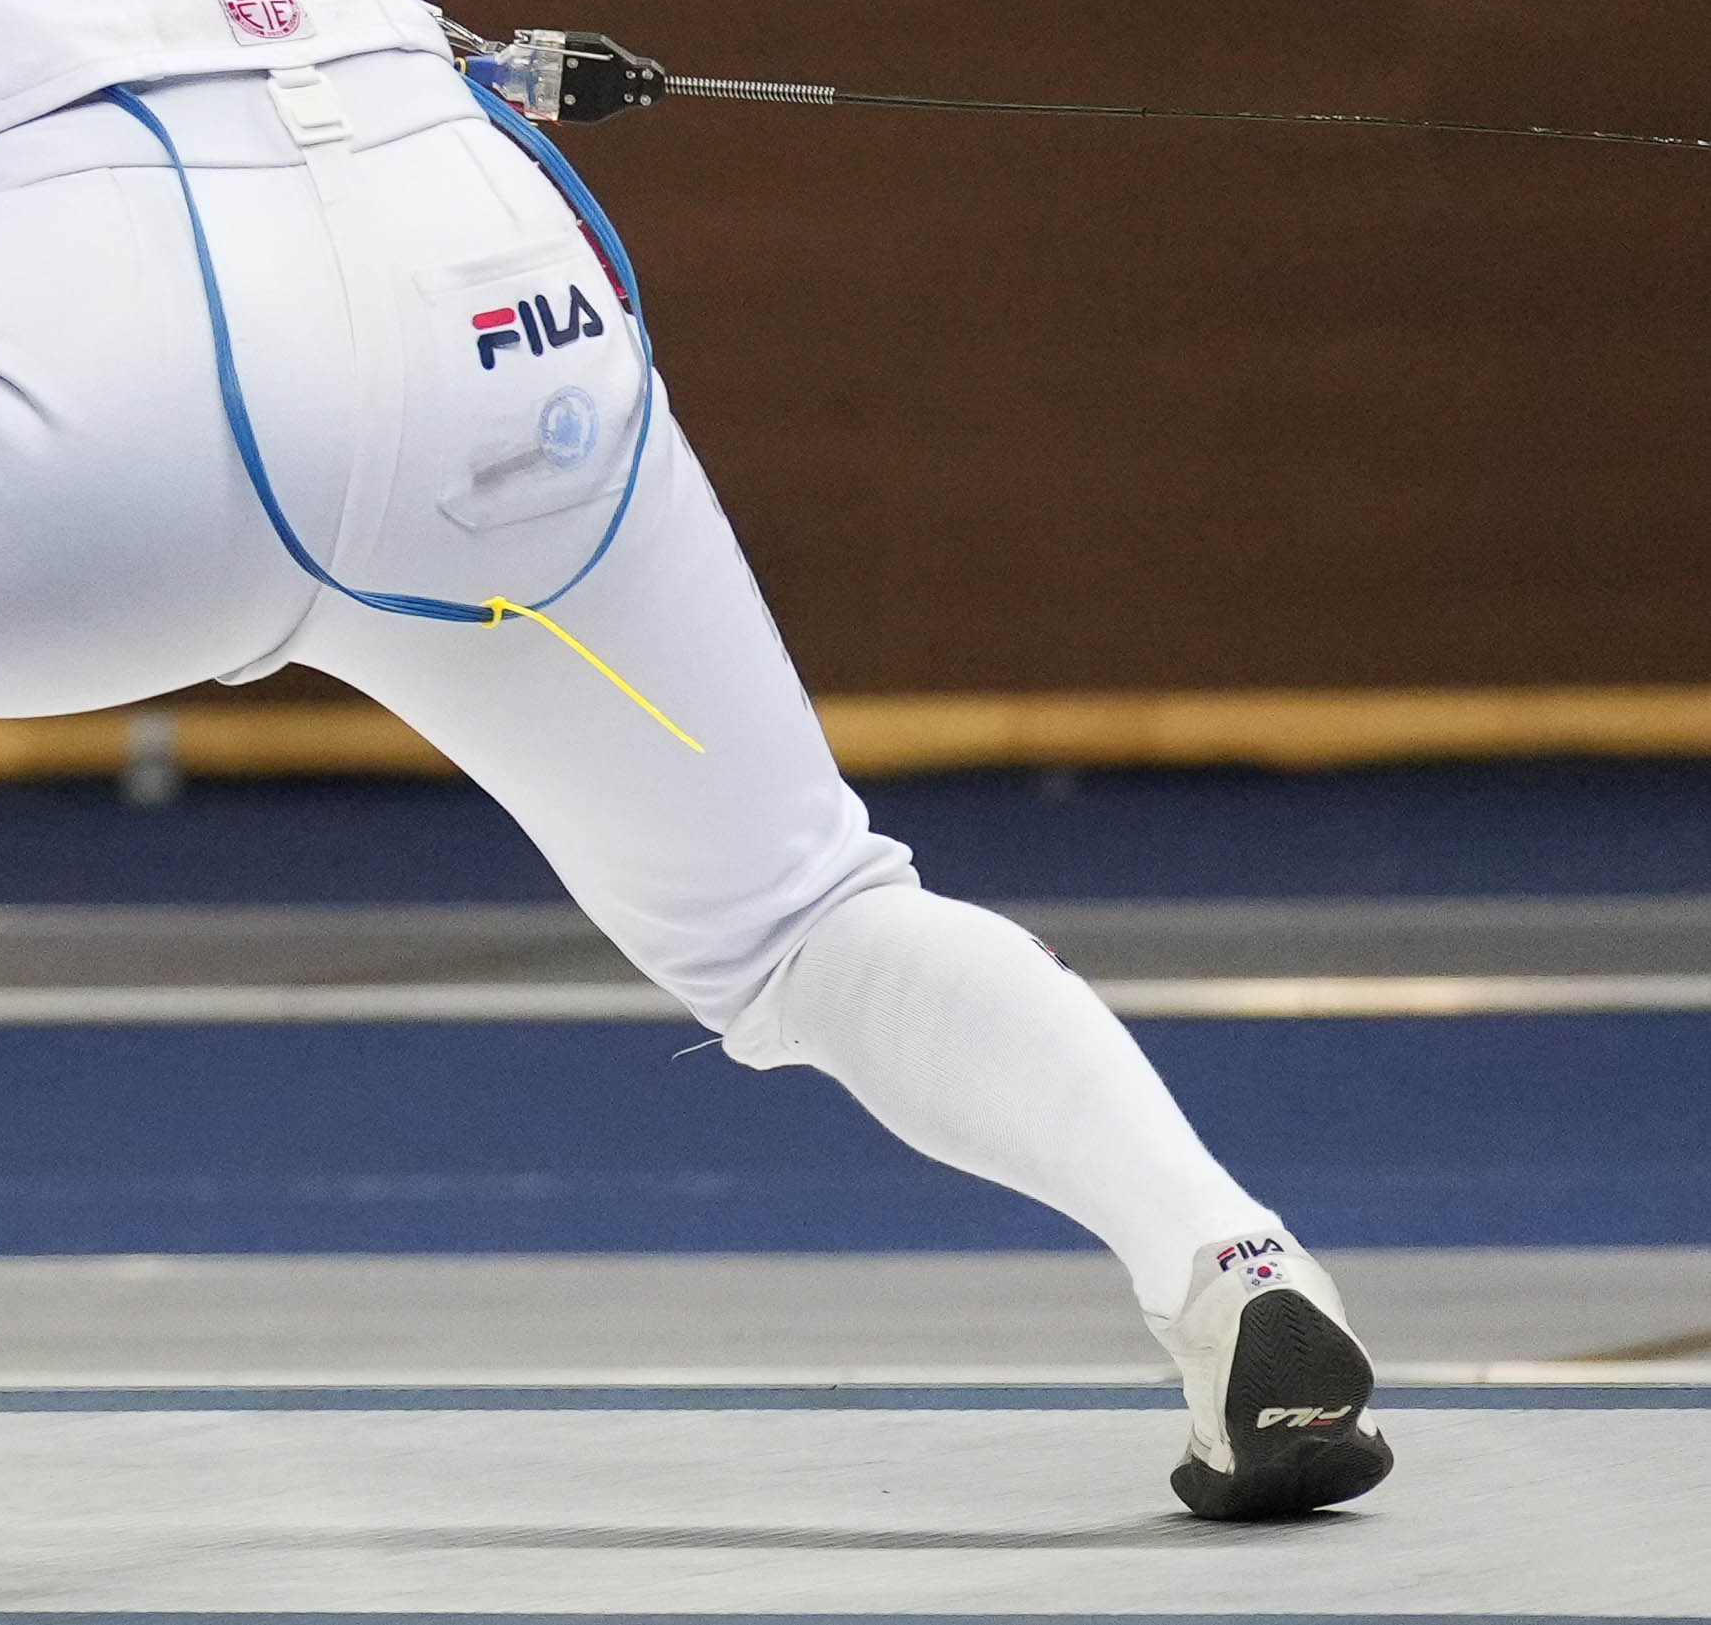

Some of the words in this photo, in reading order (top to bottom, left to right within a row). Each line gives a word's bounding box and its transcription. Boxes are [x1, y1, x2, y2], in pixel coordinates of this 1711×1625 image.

[472, 284, 604, 371] FILA
[1217, 1238, 1284, 1272] FILA
[1257, 1405, 1353, 1429] FILA
